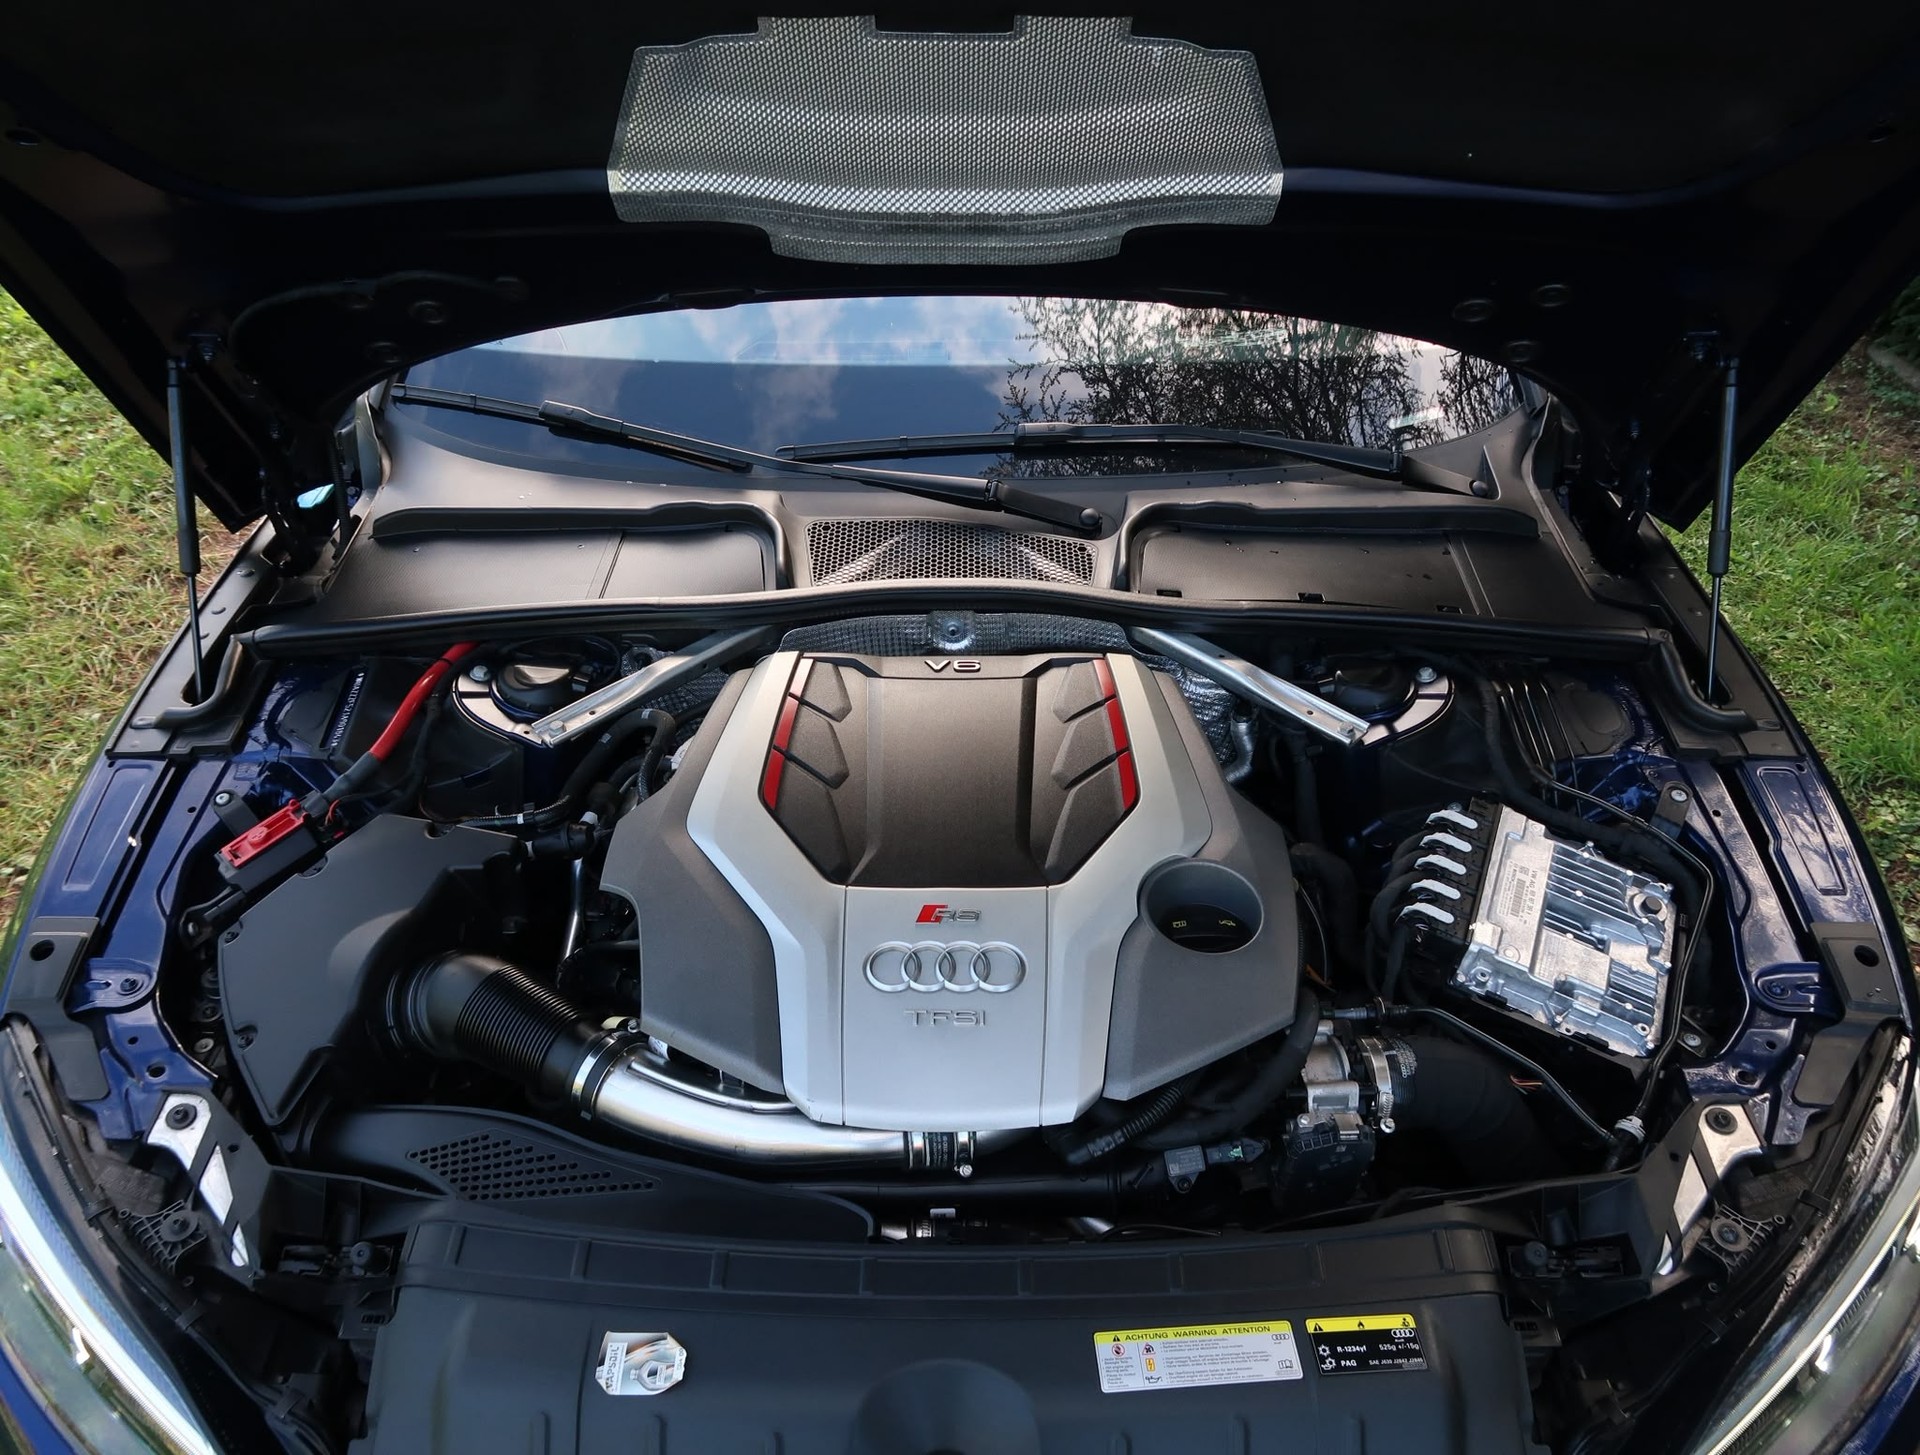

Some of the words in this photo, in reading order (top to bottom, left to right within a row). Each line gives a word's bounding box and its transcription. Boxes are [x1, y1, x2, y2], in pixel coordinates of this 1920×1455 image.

[924, 659, 981, 672] V6
[916, 904, 982, 924] RS
[904, 1009, 987, 1027] TFSI
[1125, 1331, 1168, 1341] ACHTUNG
[1173, 1328, 1217, 1338] WARNING
[1222, 1325, 1271, 1335] ATTENTION
[1336, 1344, 1367, 1354] R-1234yf
[1379, 1344, 1396, 1352] 525g
